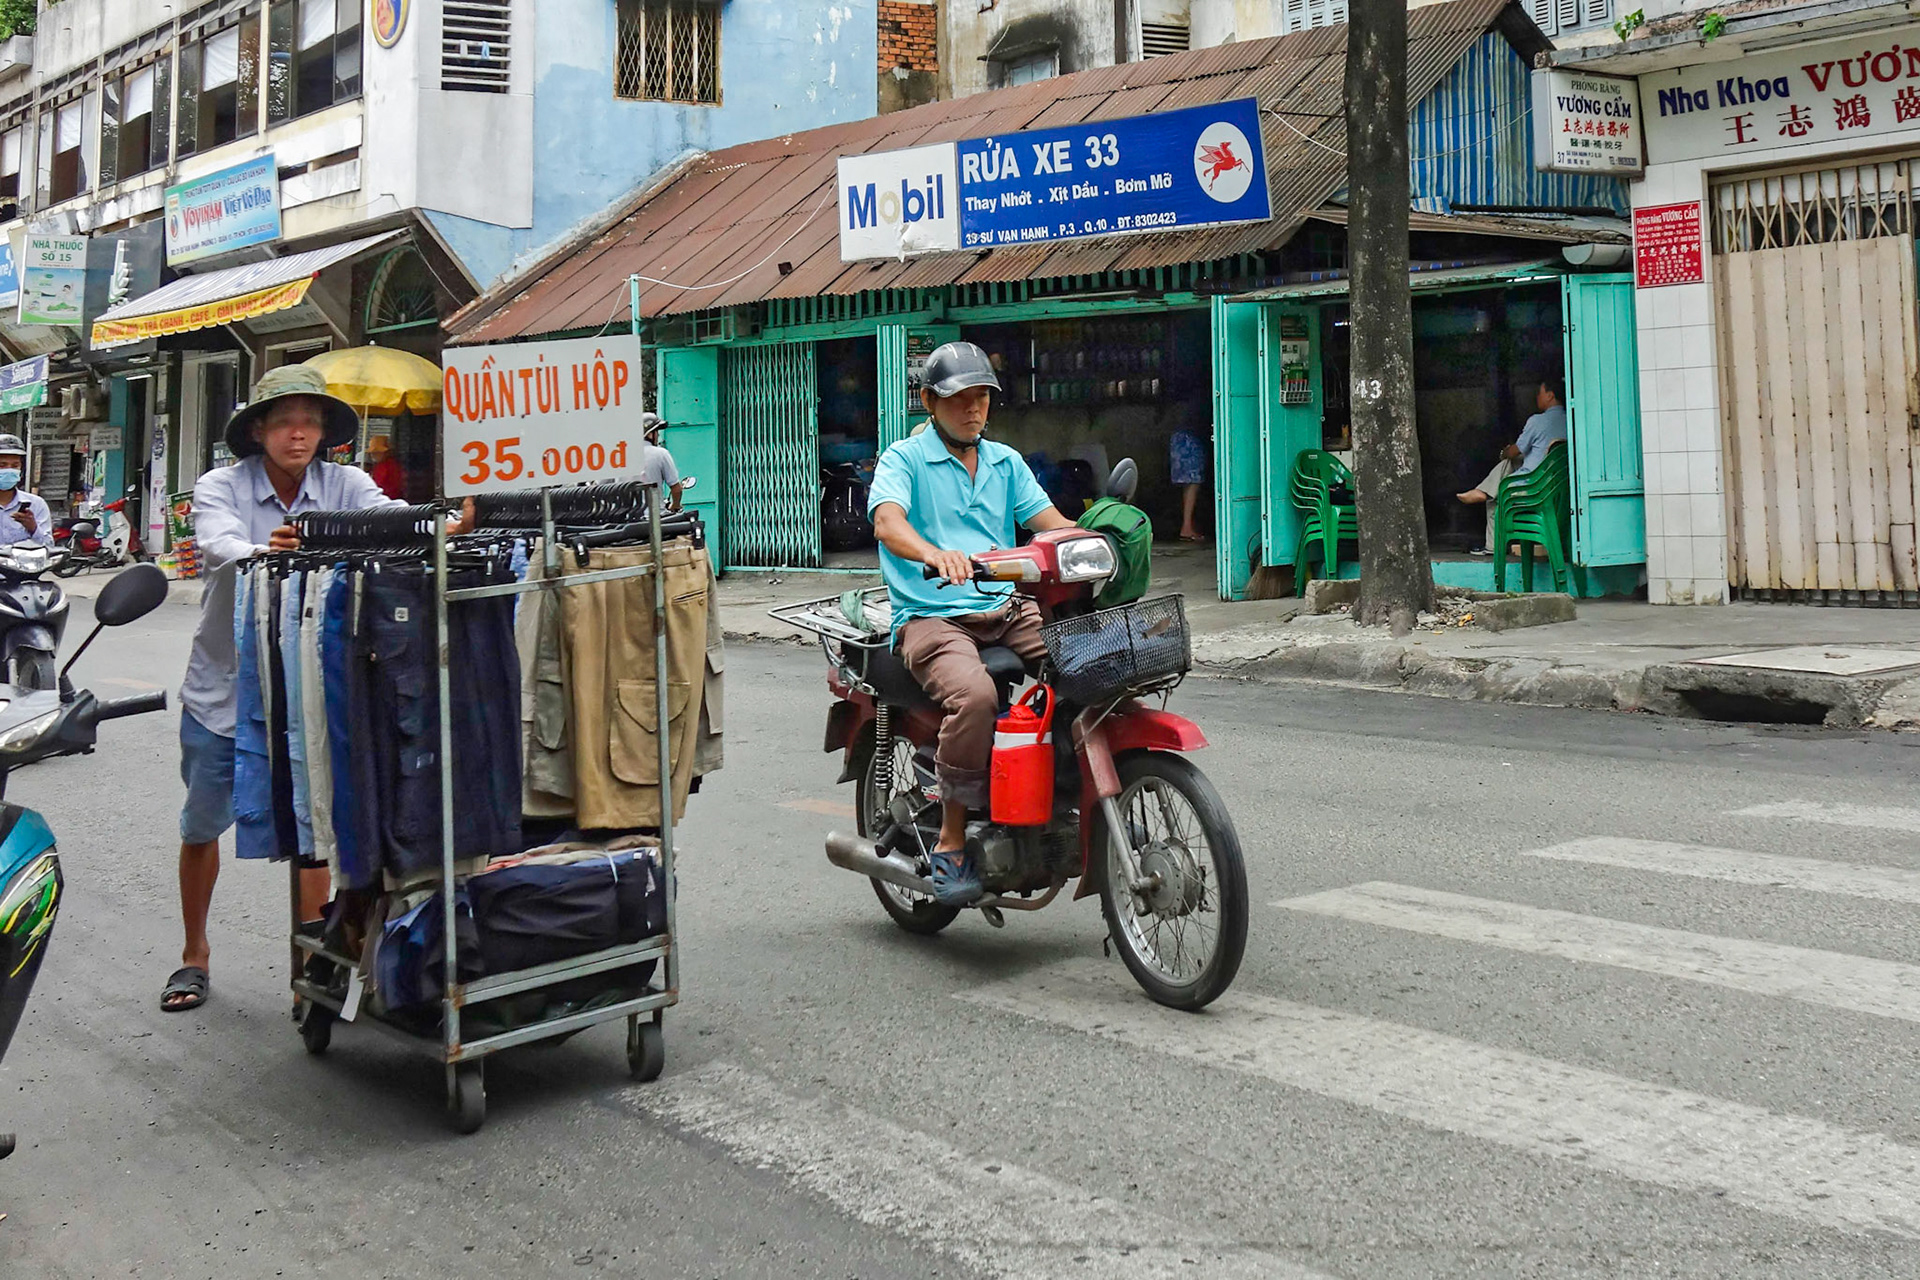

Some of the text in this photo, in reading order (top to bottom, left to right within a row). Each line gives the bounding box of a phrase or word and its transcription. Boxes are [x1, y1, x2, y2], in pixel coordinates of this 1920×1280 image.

[1557, 94, 1602, 115] VƯƠNG
[1658, 87, 1709, 117] Nha
[1717, 75, 1790, 107] Khoa
[962, 133, 1120, 184] RỬA XE 33
[1557, 151, 1565, 164] 37
[848, 174, 944, 230] Mobil
[965, 172, 1172, 213] Thay Nhớt Xịt Dầu Bơm Mỡ
[980, 229, 994, 244] SƯ
[998, 229, 1018, 244] VẠN
[1021, 226, 1049, 242] HẠNH
[1060, 222, 1075, 236] P.3
[1085, 218, 1107, 234] Q.10
[60, 254, 72, 262] 15
[445, 355, 515, 423] QUẦN
[519, 354, 560, 415] TÚI
[460, 437, 627, 485] 35.000đ
